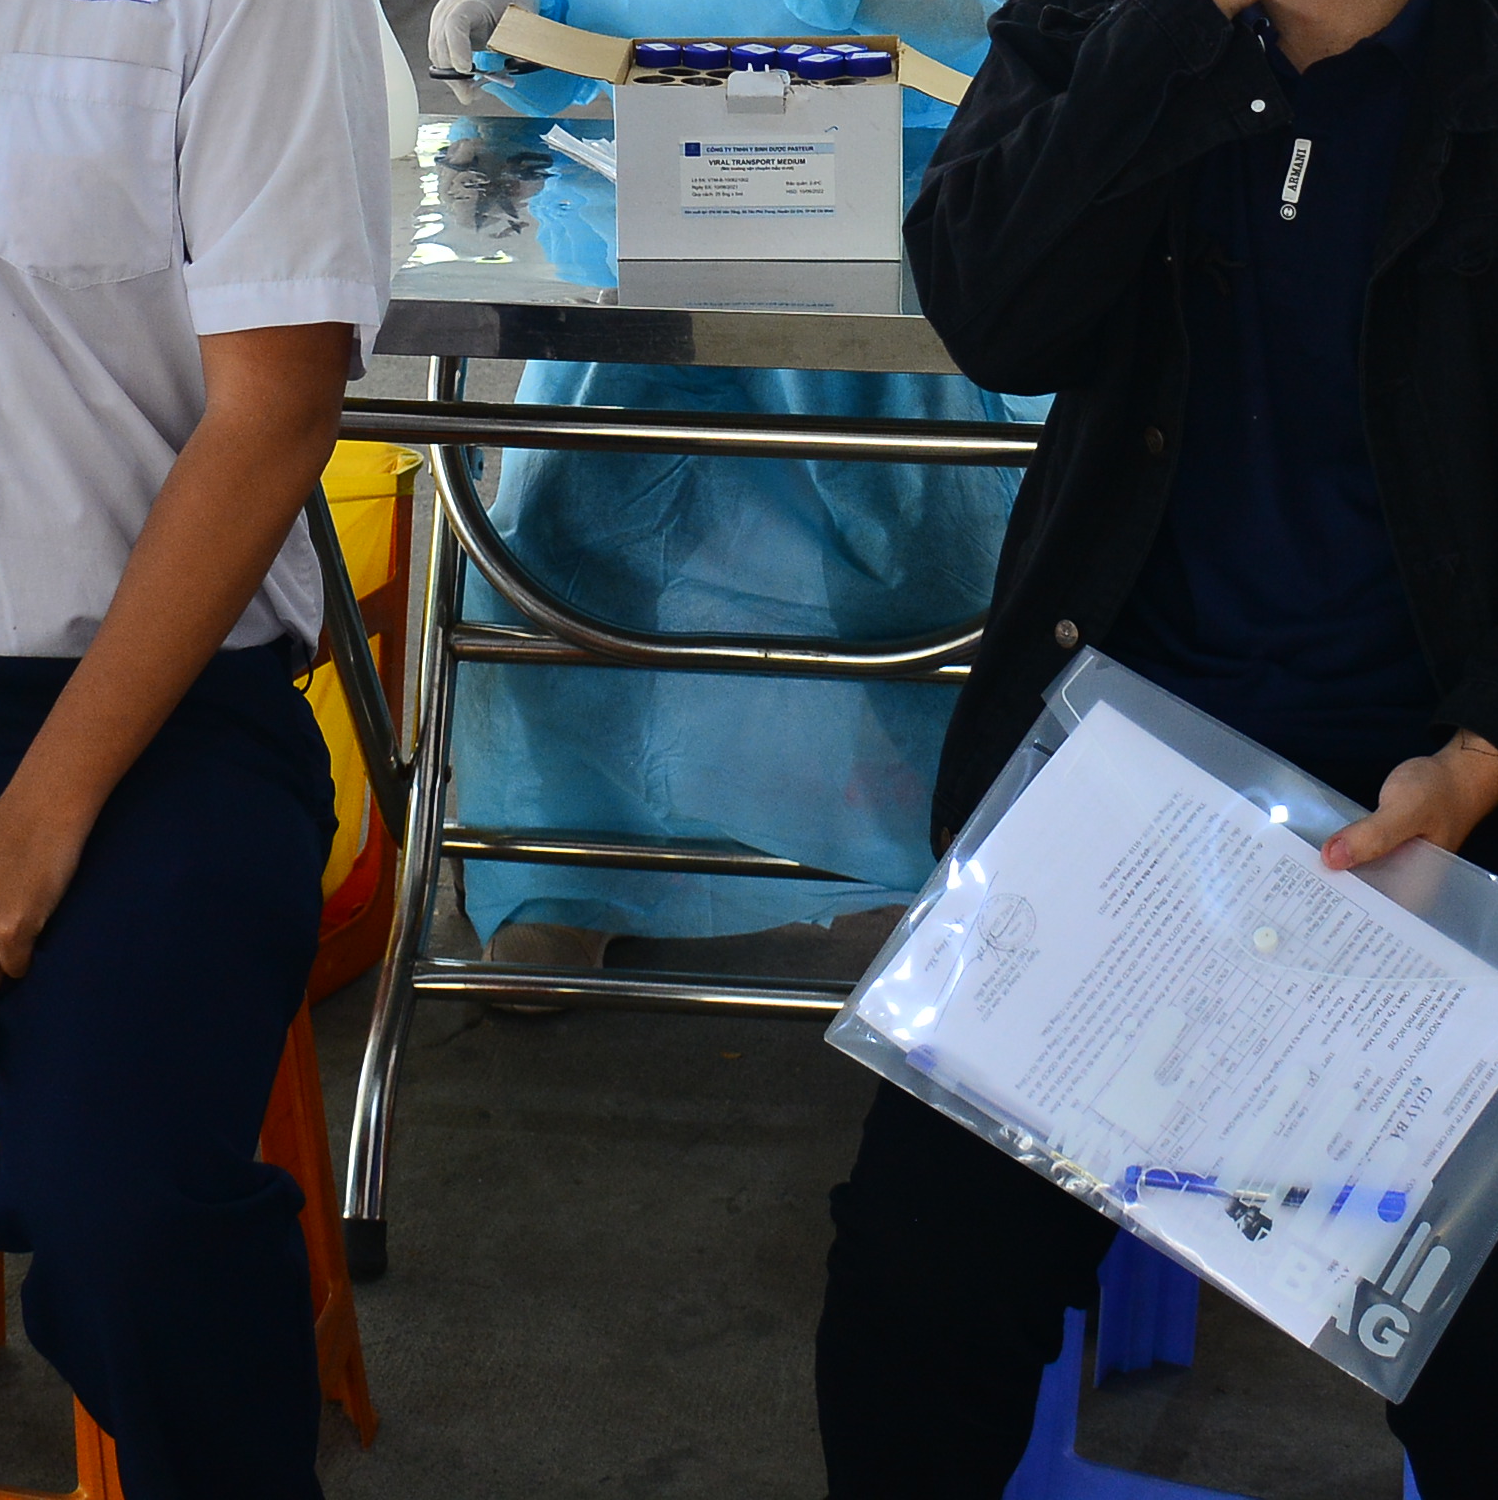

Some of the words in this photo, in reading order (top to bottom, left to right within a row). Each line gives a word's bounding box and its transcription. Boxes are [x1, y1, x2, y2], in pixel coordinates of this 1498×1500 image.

[1287, 148, 1307, 192] ARMANI
[1386, 1065, 1407, 1089] MINH
[1387, 1118, 1412, 1144] BÁ
[1271, 1246, 1411, 1358] BAG
